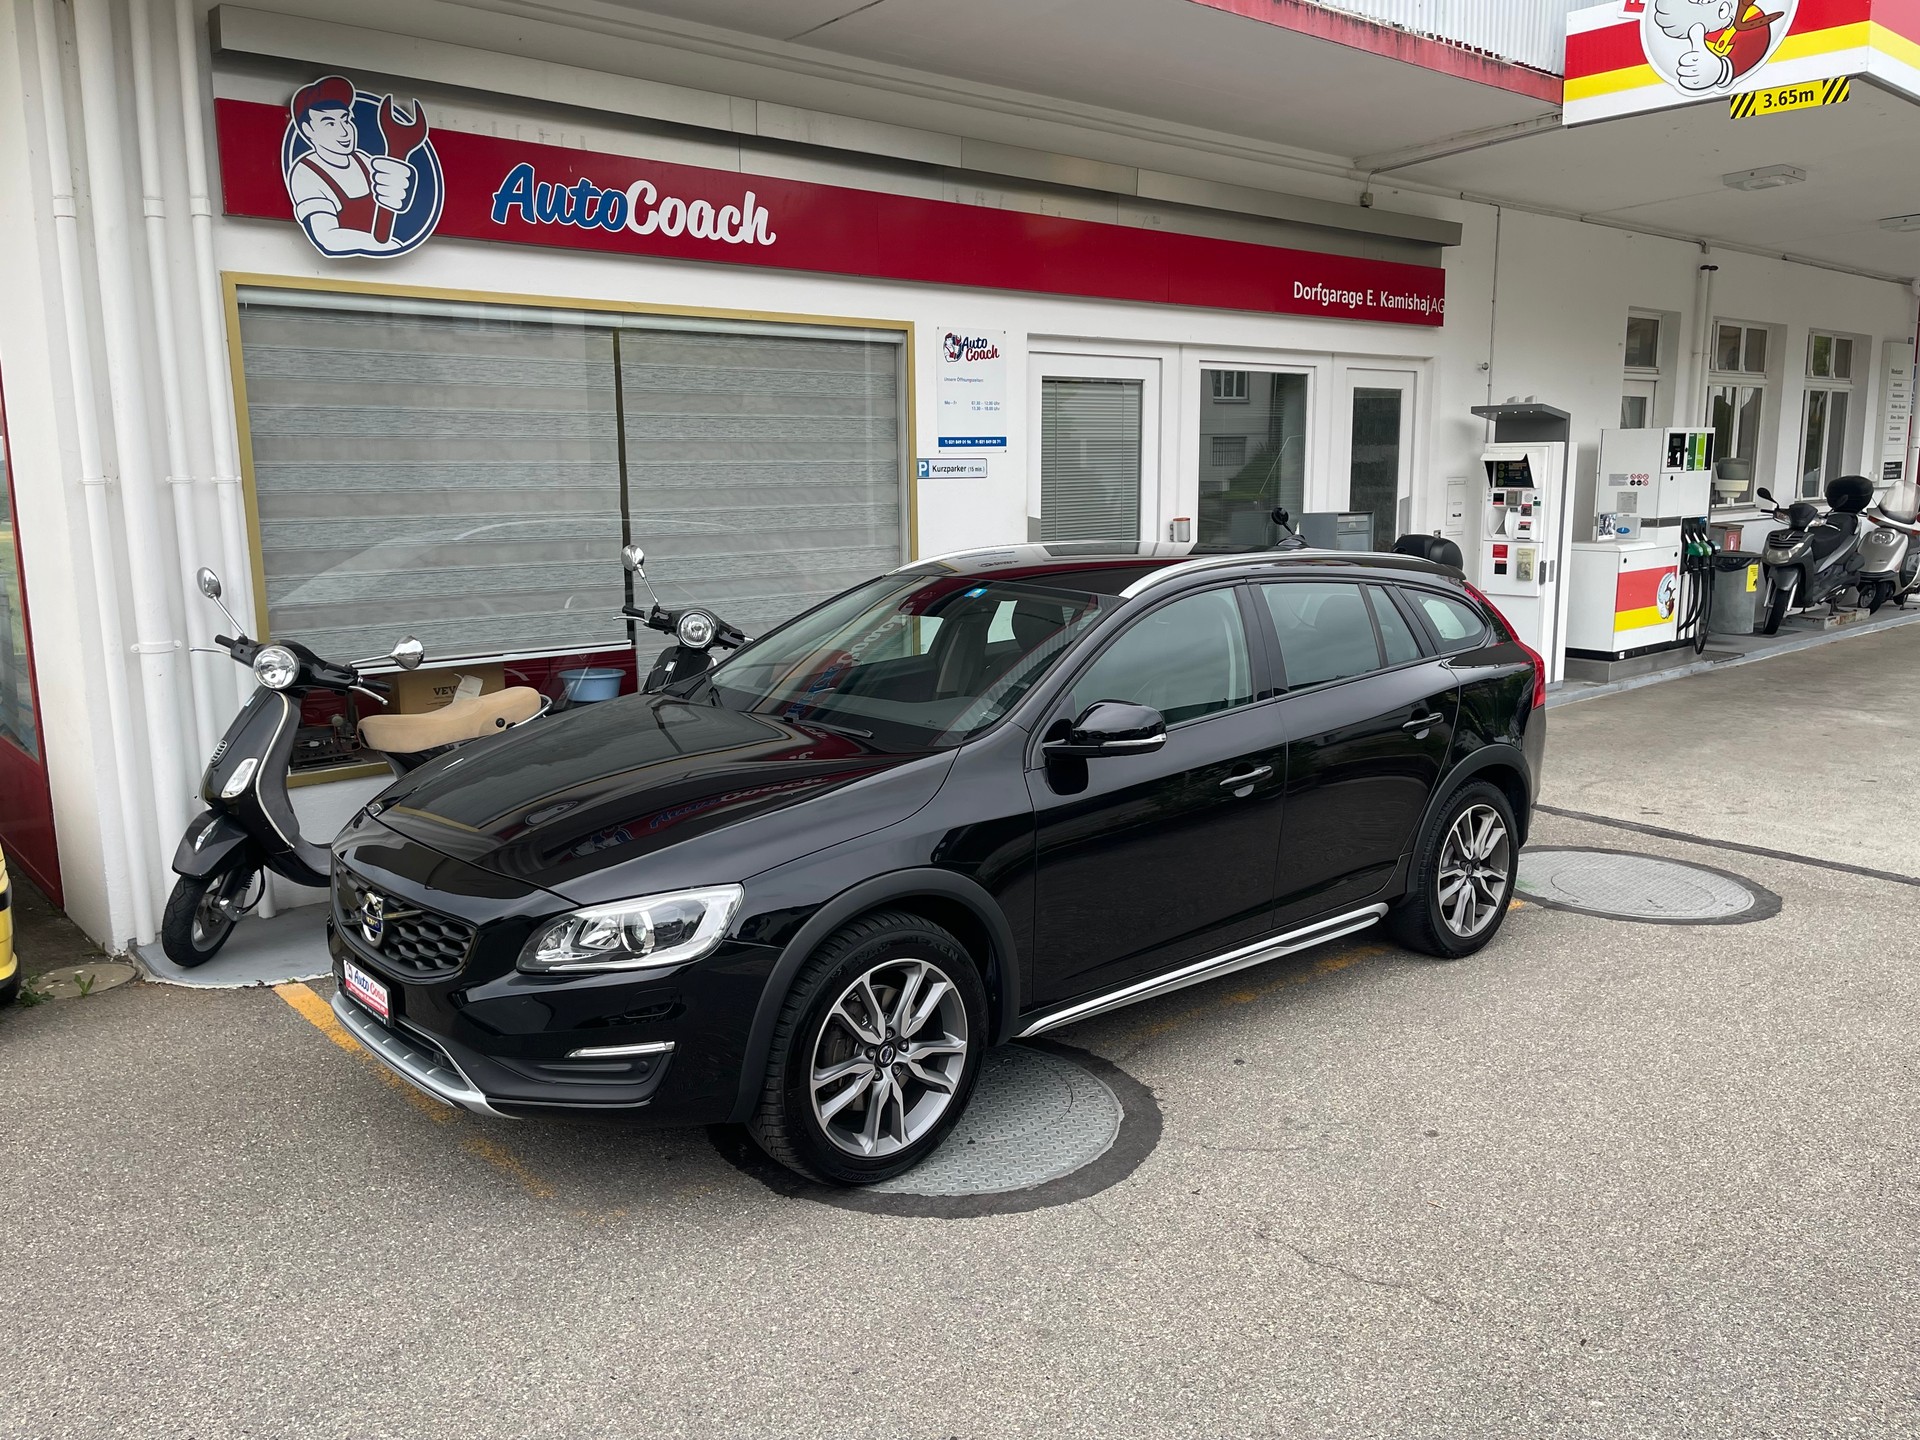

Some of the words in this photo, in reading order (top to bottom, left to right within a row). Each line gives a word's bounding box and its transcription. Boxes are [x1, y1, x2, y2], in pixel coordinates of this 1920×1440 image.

[1763, 89, 1814, 108] 3.65m
[1293, 281, 1363, 309] Dorfgarage
[1366, 289, 1377, 307] E.
[1380, 291, 1430, 315] Kamishaj
[961, 336, 988, 352] Auto
[965, 344, 1000, 362] Coach
[1675, 452, 1680, 465] 1
[918, 461, 928, 477] P
[932, 465, 967, 474] Kurzparker
[353, 968, 370, 993] Auto
